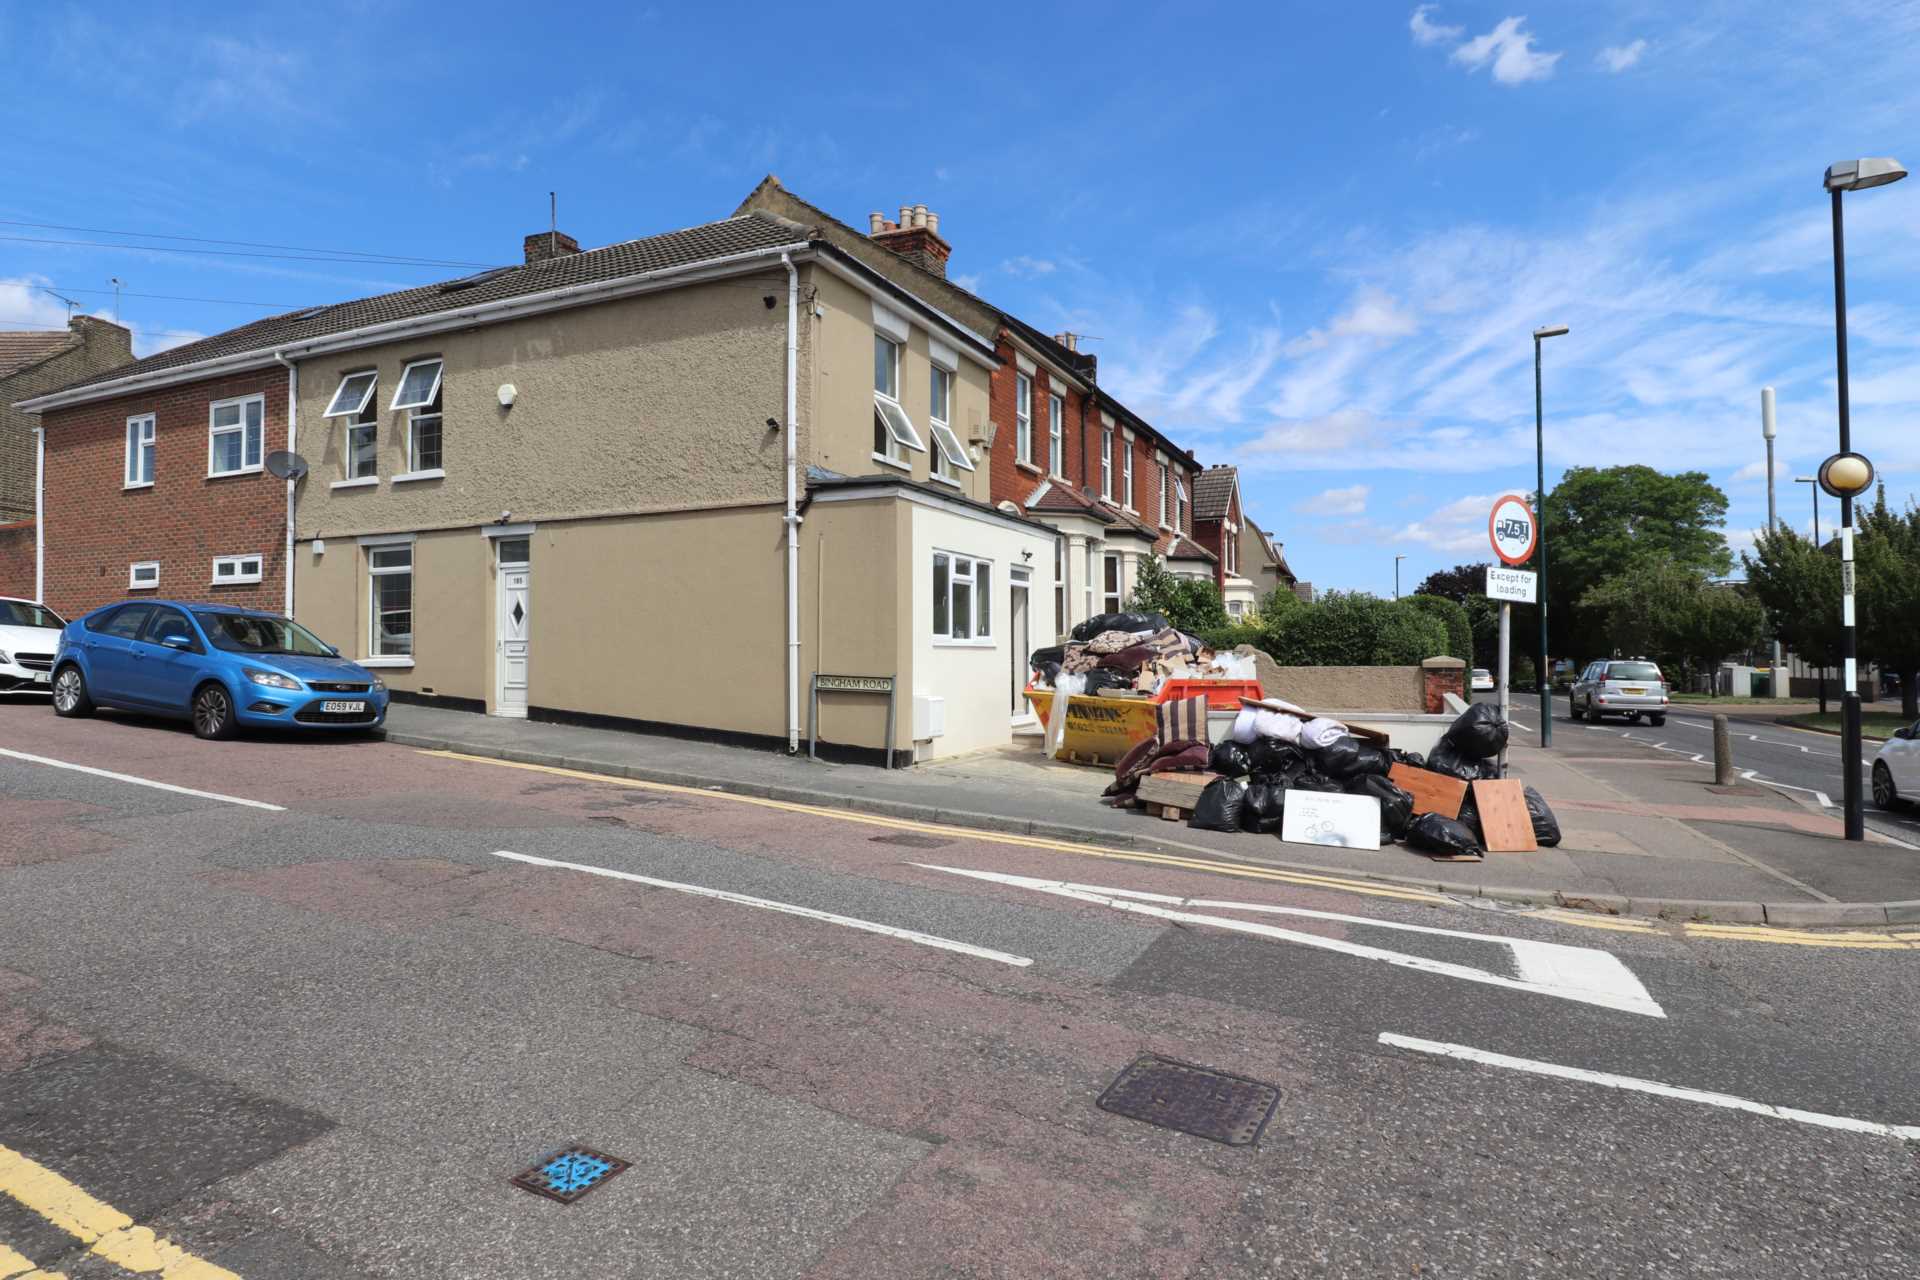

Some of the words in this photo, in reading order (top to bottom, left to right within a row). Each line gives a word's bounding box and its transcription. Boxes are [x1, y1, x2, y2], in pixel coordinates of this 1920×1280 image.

[1490, 571, 1519, 584] Except
[1520, 573, 1532, 584] for
[1496, 584, 1527, 598] loading
[820, 678, 860, 689] BINGHAM
[863, 679, 890, 690] ROAD
